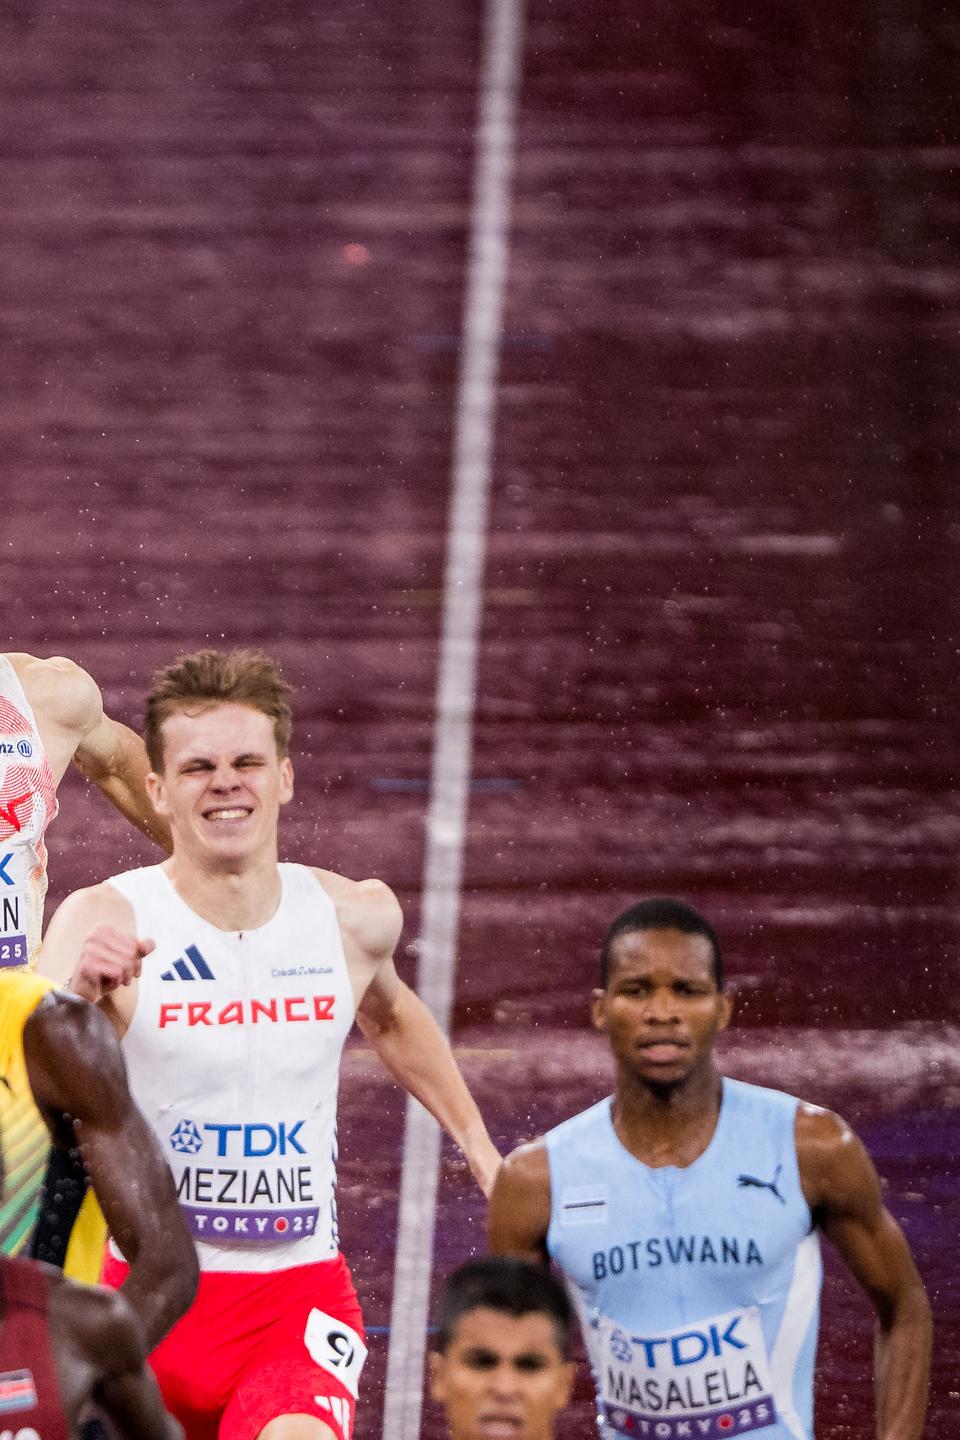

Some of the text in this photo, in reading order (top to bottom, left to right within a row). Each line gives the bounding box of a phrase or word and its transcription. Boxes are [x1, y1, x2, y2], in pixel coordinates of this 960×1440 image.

[157, 994, 336, 1029] FRANCE
[203, 1119, 308, 1157] TDK
[591, 1235, 764, 1281] BOTSWANA
[631, 1316, 749, 1369] TDK
[607, 1359, 764, 1411] MASALELA
